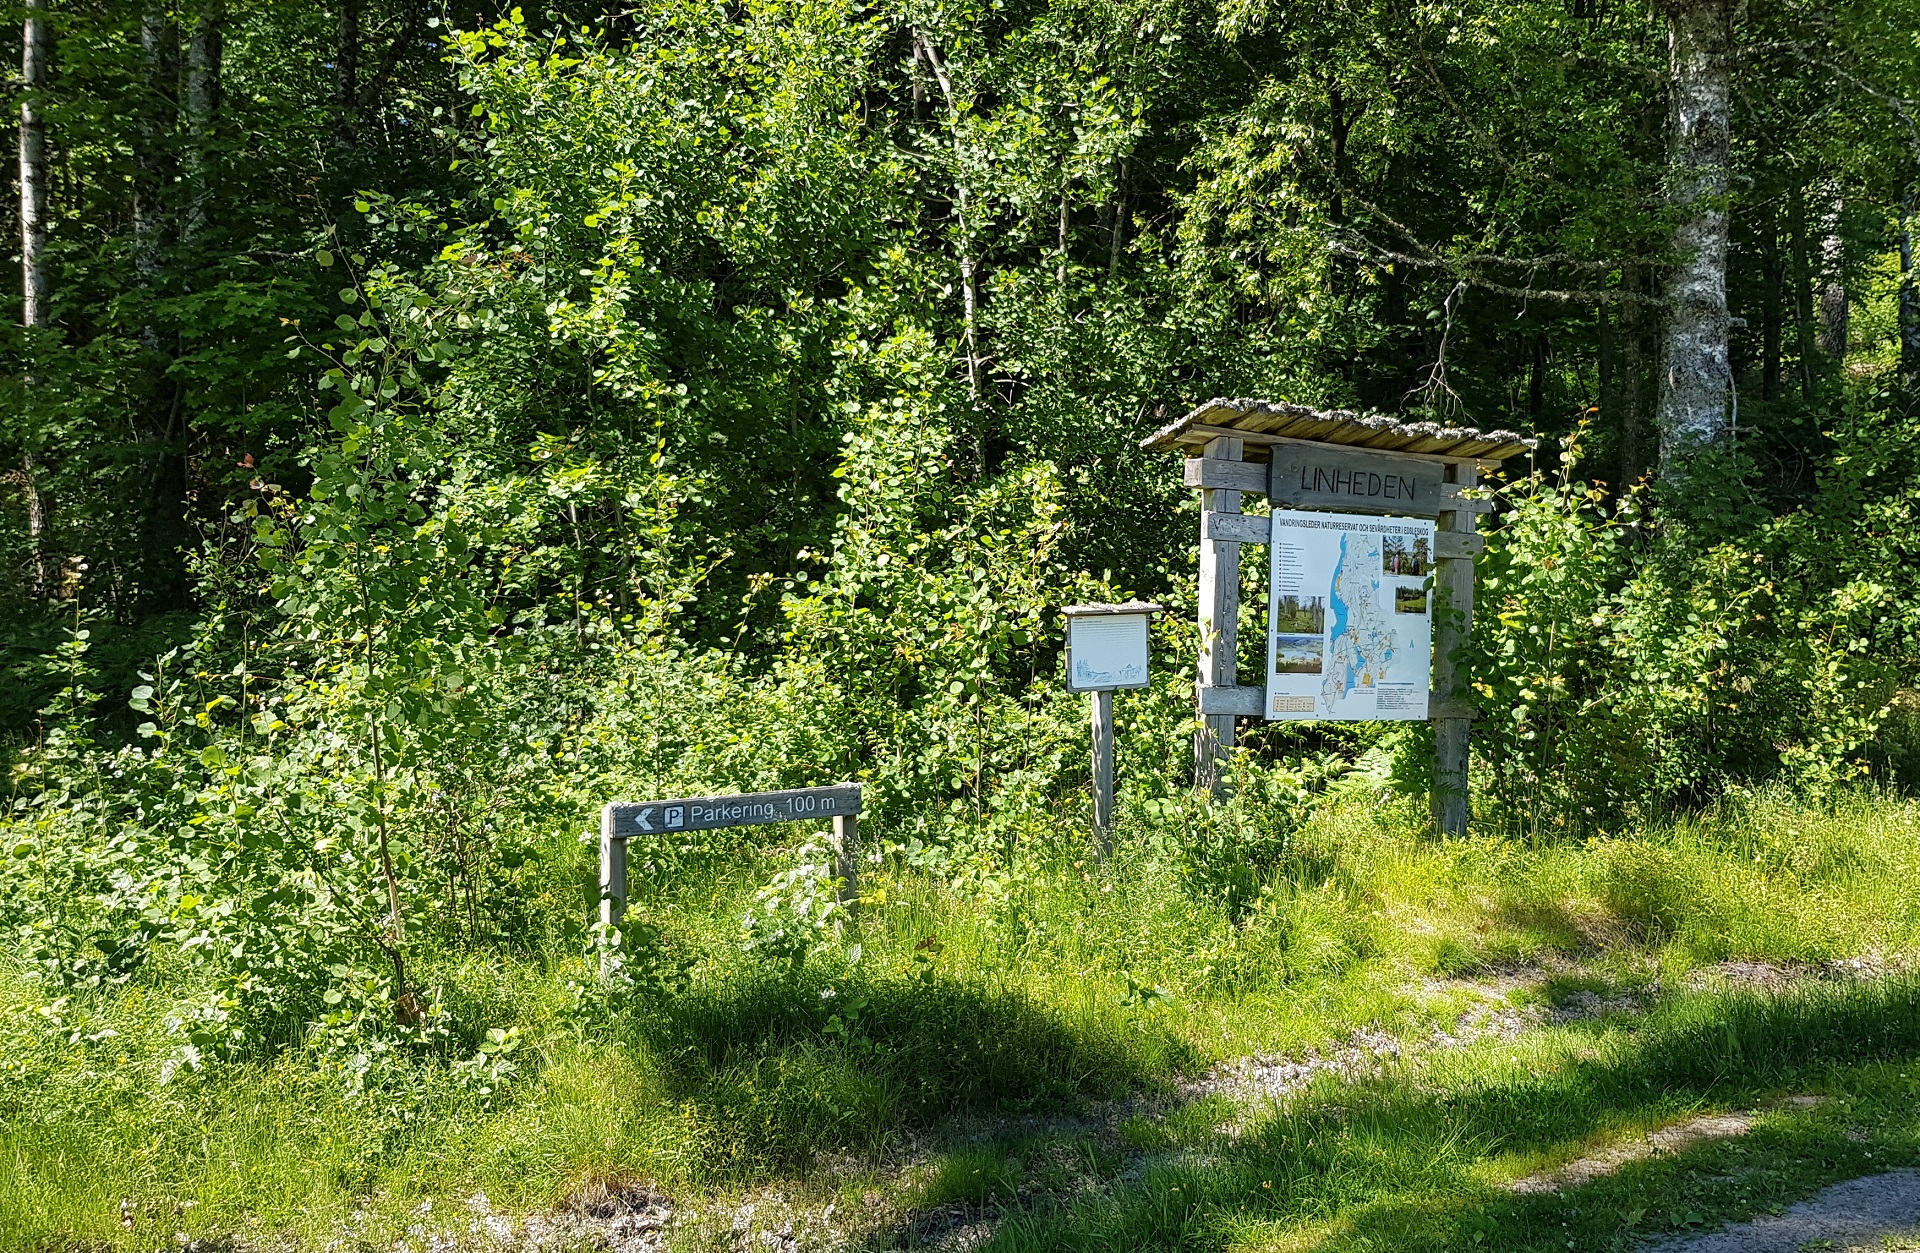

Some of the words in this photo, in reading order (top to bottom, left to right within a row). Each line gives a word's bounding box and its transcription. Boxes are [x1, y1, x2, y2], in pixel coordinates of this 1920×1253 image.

[1301, 465, 1416, 501] LINHEDEN
[1279, 518, 1320, 529] VANDRINGSLEDER
[1321, 521, 1358, 531] NATURRESERVAT
[1359, 523, 1368, 532] OCH
[1404, 526, 1429, 536] EDSLESKOG
[691, 802, 774, 823] Parkering
[786, 795, 815, 813] 100
[821, 796, 835, 810] m
